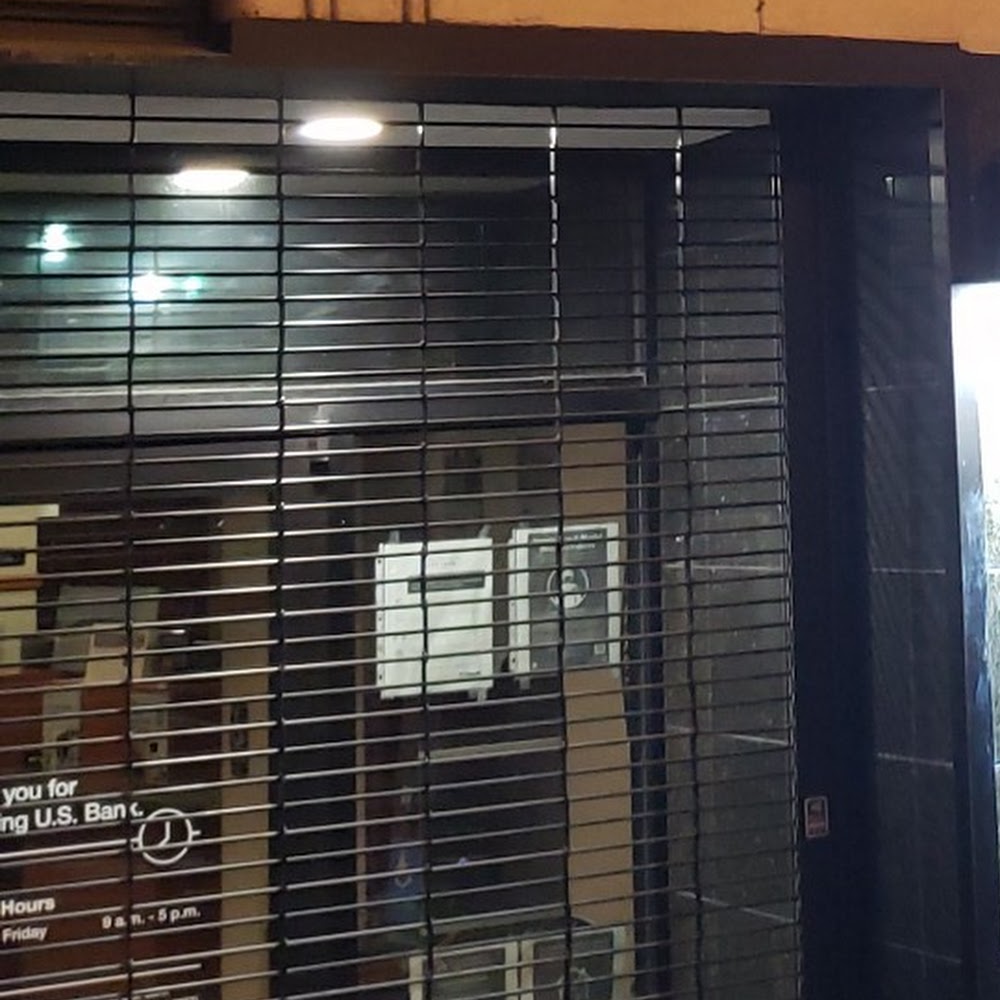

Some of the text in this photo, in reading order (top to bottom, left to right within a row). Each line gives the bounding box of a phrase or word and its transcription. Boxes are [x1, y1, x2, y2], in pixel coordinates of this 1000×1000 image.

[2, 778, 78, 807] you for
[34, 804, 78, 828] U.S.
[1, 897, 56, 917] Hours
[2, 926, 48, 944] Friday
[158, 907, 168, 922] 5
[169, 906, 201, 924] p.m.
